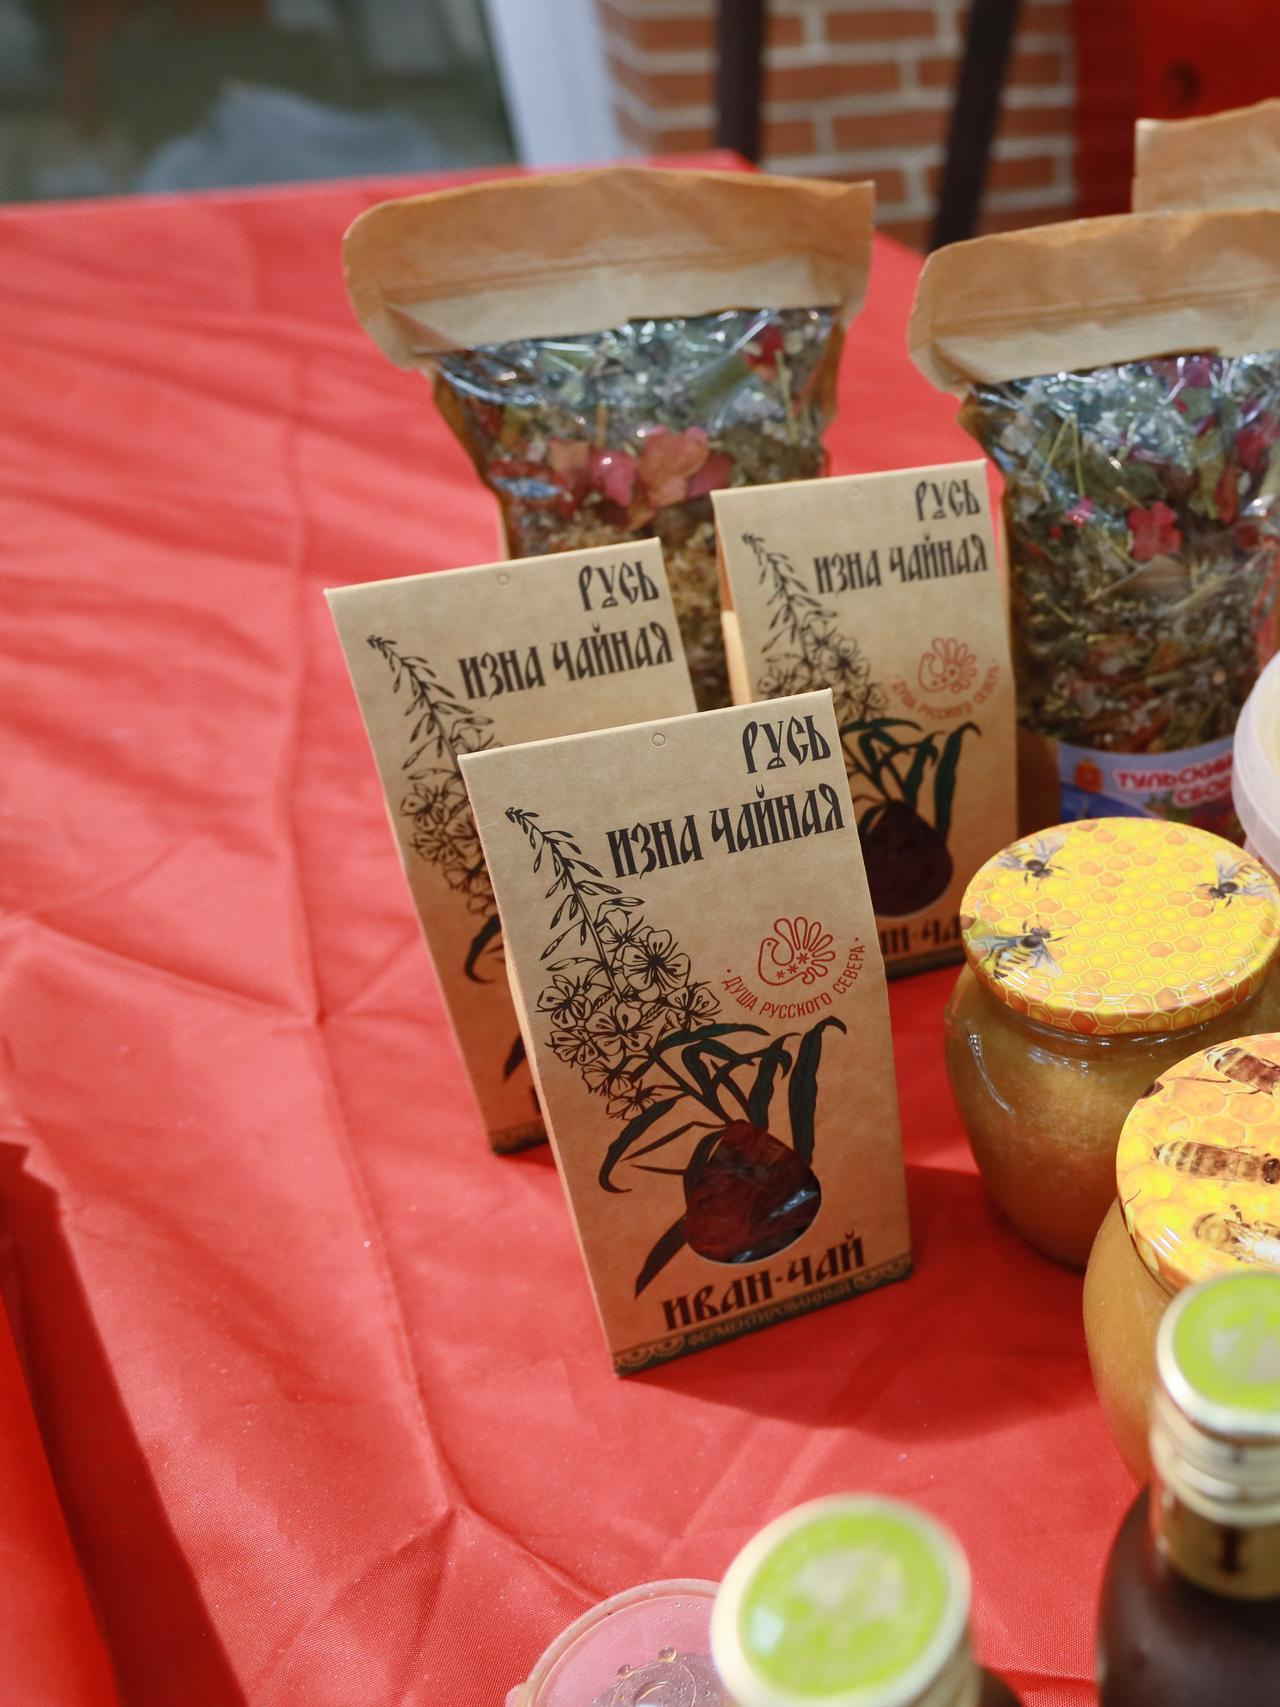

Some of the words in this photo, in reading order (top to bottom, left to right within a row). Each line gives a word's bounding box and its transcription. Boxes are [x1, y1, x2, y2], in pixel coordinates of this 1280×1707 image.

[915, 479, 980, 522] РУСЬ
[578, 561, 660, 612] РУСЬ
[813, 549, 882, 596] ИЗНА
[889, 530, 988, 583] ЧАЙНАЯ
[458, 646, 546, 701] ИЗНА
[551, 620, 674, 681] ЧАЙНАЯ
[742, 715, 831, 774] РУСЬ
[605, 815, 704, 880] ИЗНА
[709, 783, 845, 854] ЧАЙНАЯ
[721, 976, 758, 1011] ДУША
[758, 992, 832, 1019] РУССКОГО
[832, 945, 866, 995] СЕВЕРА
[661, 1230, 865, 1331] ИВАН-ЧАЙ
